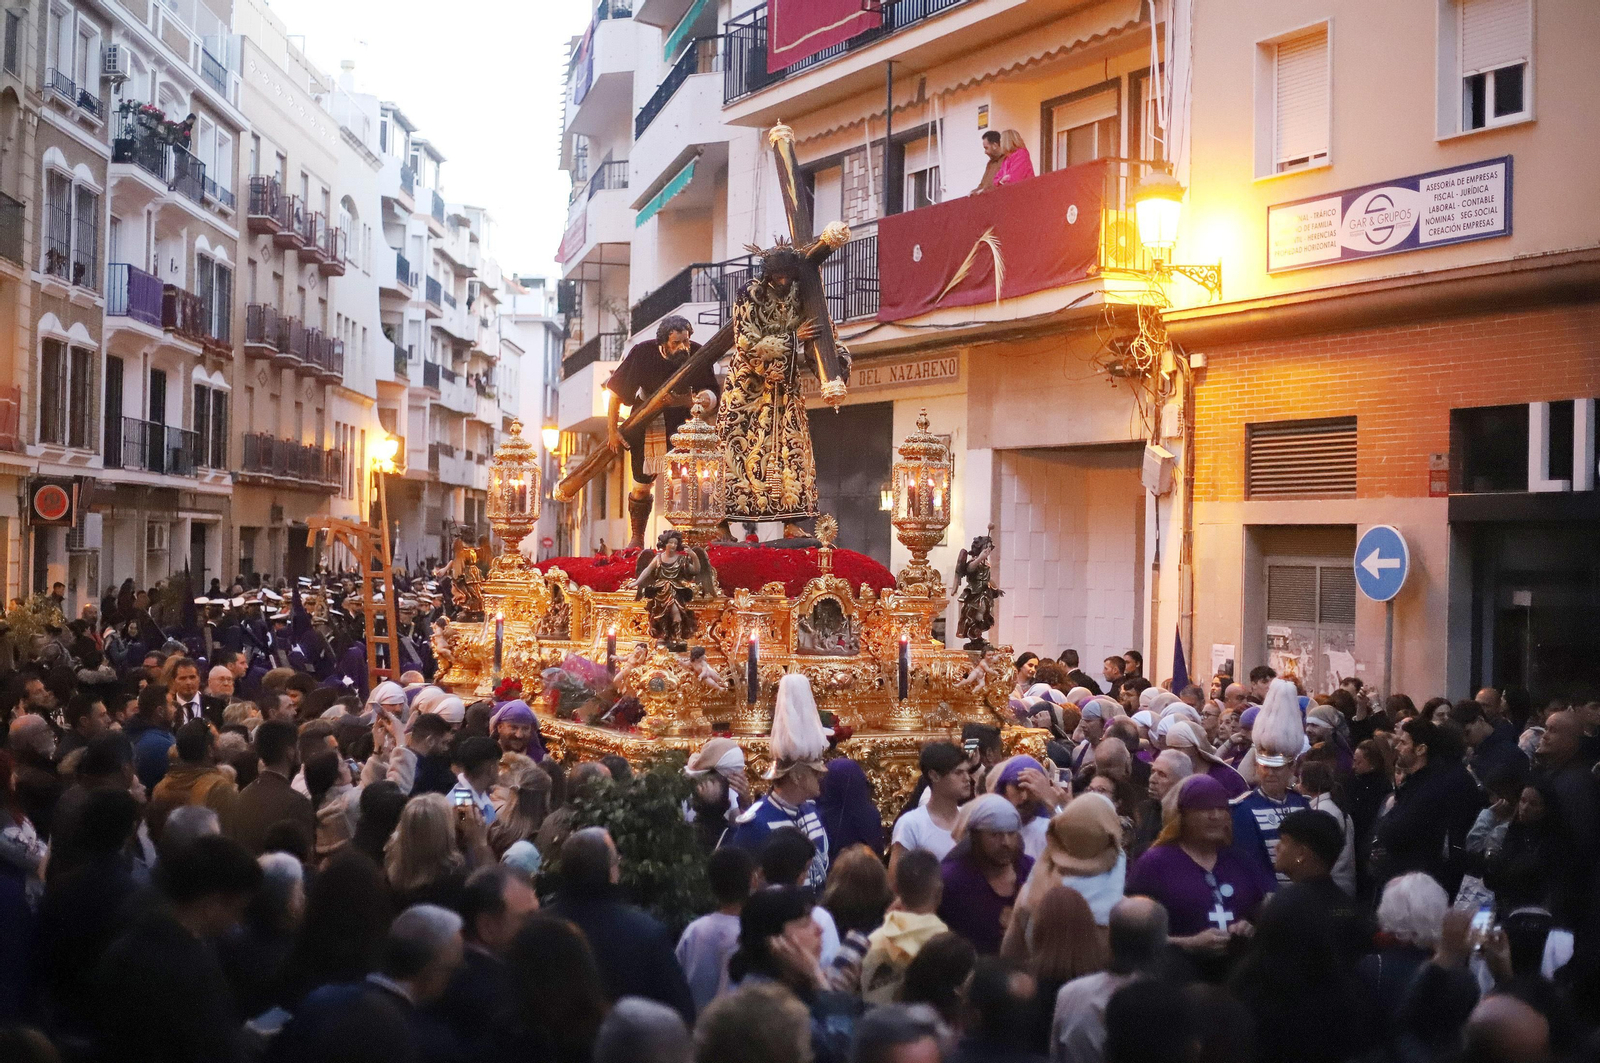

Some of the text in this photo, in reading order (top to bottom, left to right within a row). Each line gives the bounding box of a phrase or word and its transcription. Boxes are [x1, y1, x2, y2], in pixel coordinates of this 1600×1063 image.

[1426, 171, 1498, 192] ASESORÍA DE EMPRESAS
[1434, 191, 1454, 201] FISCAL
[1460, 185, 1489, 197] JURÍDICA
[1428, 202, 1456, 214] LABORAL
[1461, 195, 1495, 208] CONTABLE
[1314, 208, 1337, 219] TRÁFICO
[1425, 213, 1455, 226] NÓMINAS
[1303, 224, 1310, 232] DE
[1311, 220, 1332, 230] FAMILIA
[1349, 217, 1367, 230] GAR
[1369, 216, 1375, 226] &
[1428, 218, 1495, 237] CREACIÓN EMPRESAS
[1307, 230, 1337, 241] HERENCIAS
[1303, 241, 1337, 253] HORIZONTAL
[859, 369, 881, 387] DEL
[889, 358, 957, 383] NAZARENO
[1528, 398, 1600, 493] LI
